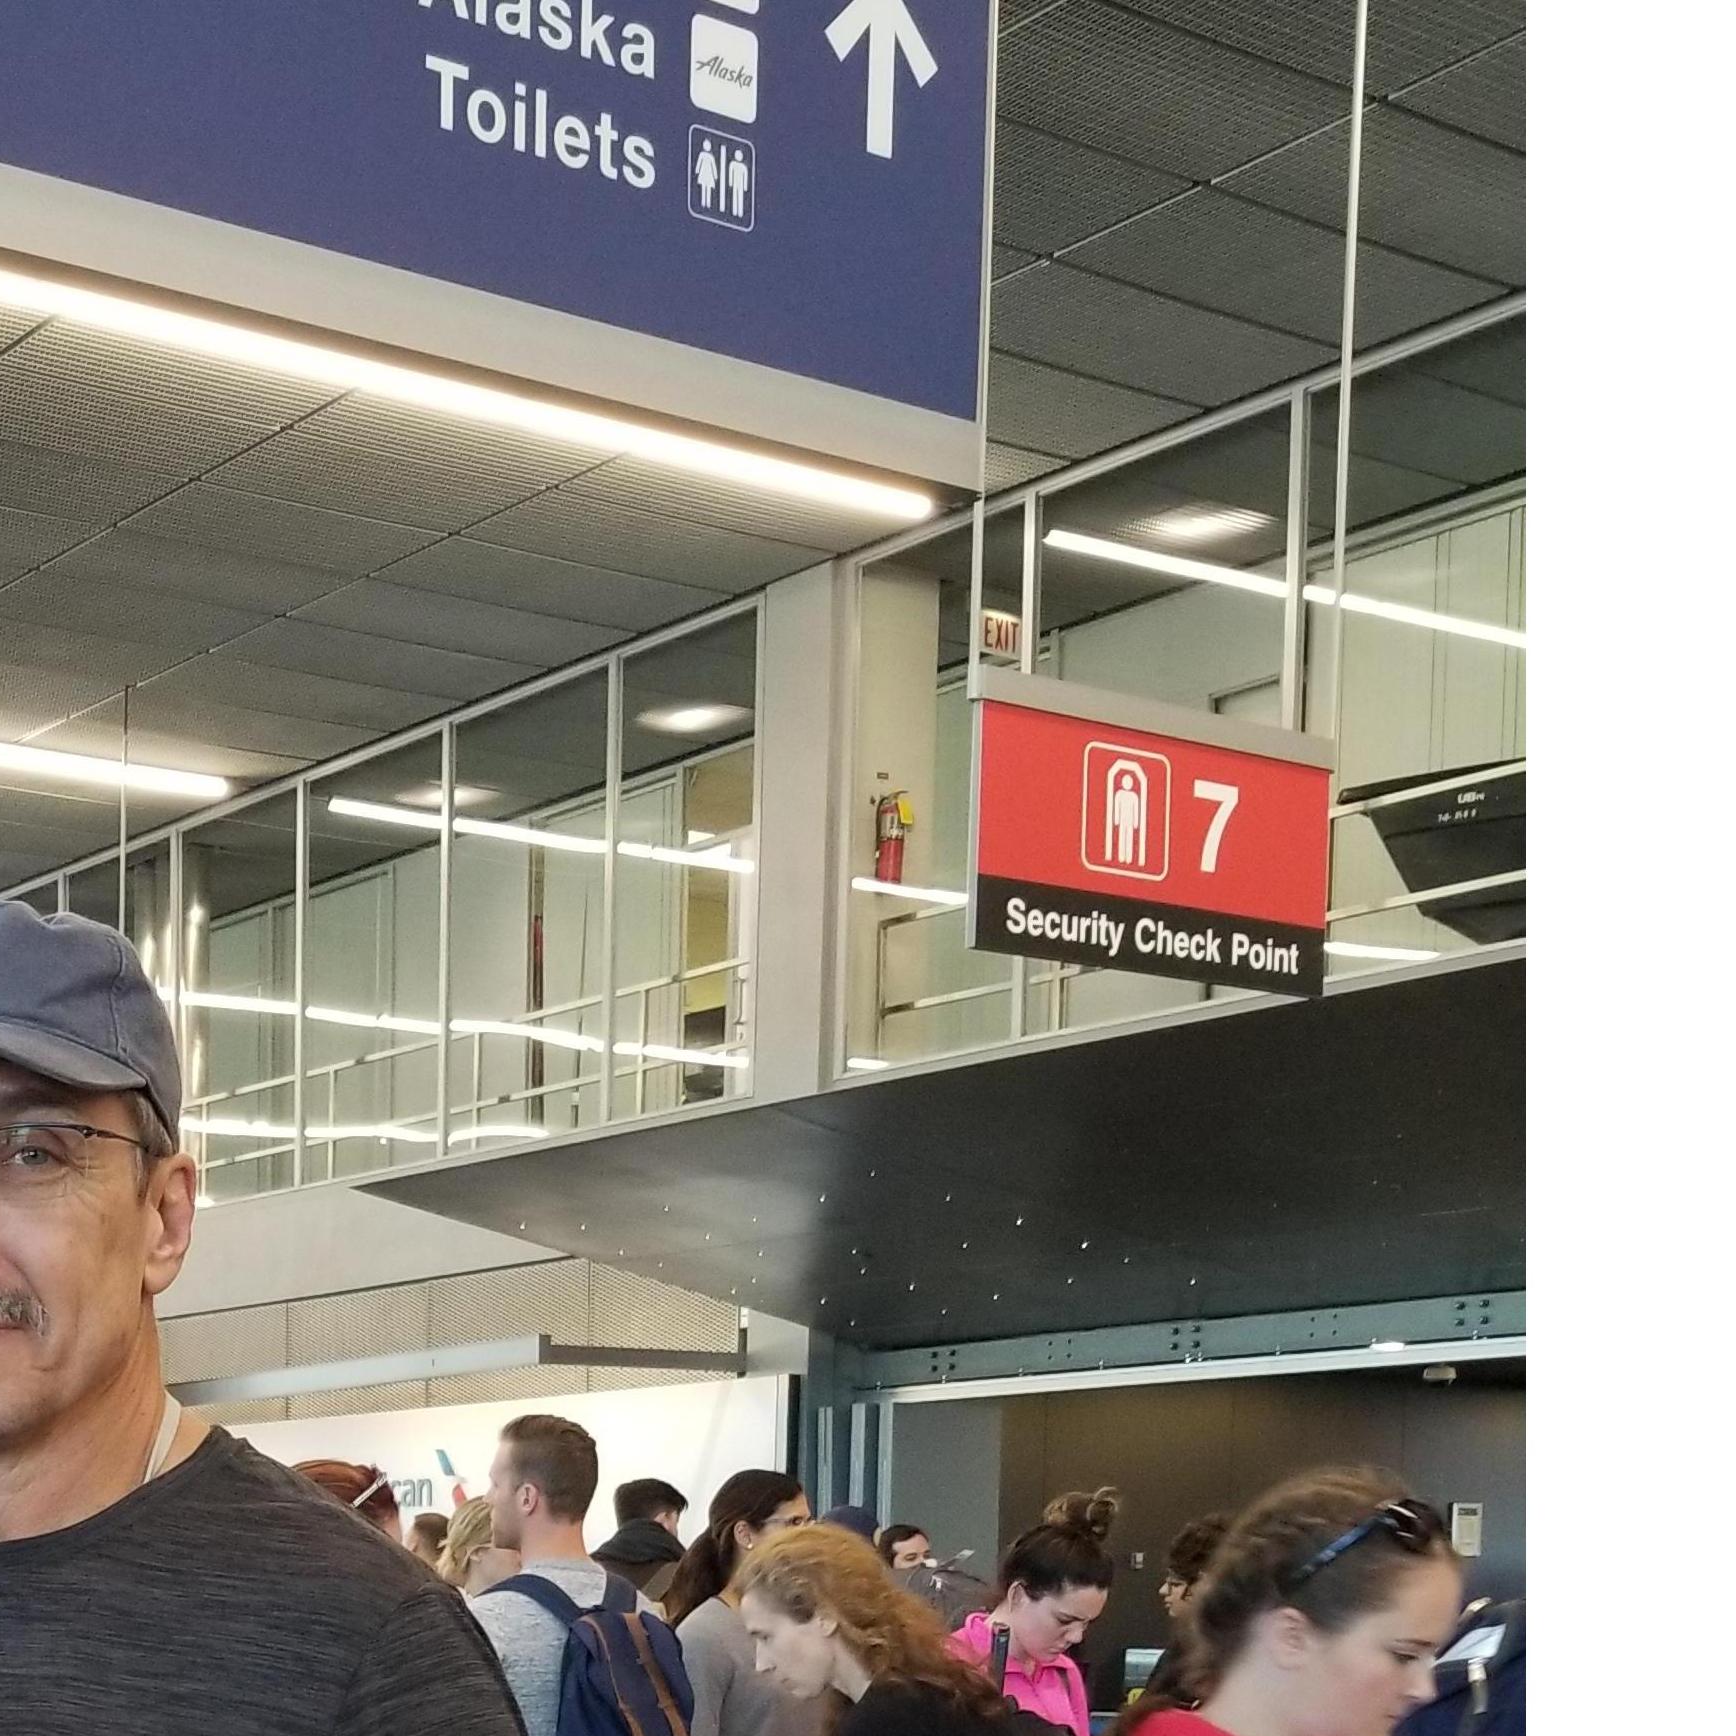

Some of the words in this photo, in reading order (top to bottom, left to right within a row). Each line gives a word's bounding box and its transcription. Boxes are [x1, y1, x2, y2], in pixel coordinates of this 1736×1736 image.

[418, 0, 655, 79] aska
[695, 55, 754, 89] Alaska
[425, 53, 656, 189] Toilets
[984, 616, 1019, 654] EXIT
[1192, 779, 1240, 874] 7
[1005, 896, 1125, 958] Security
[1134, 916, 1222, 965] Check
[1231, 930, 1301, 975] Point
[391, 1478, 433, 1508] can
